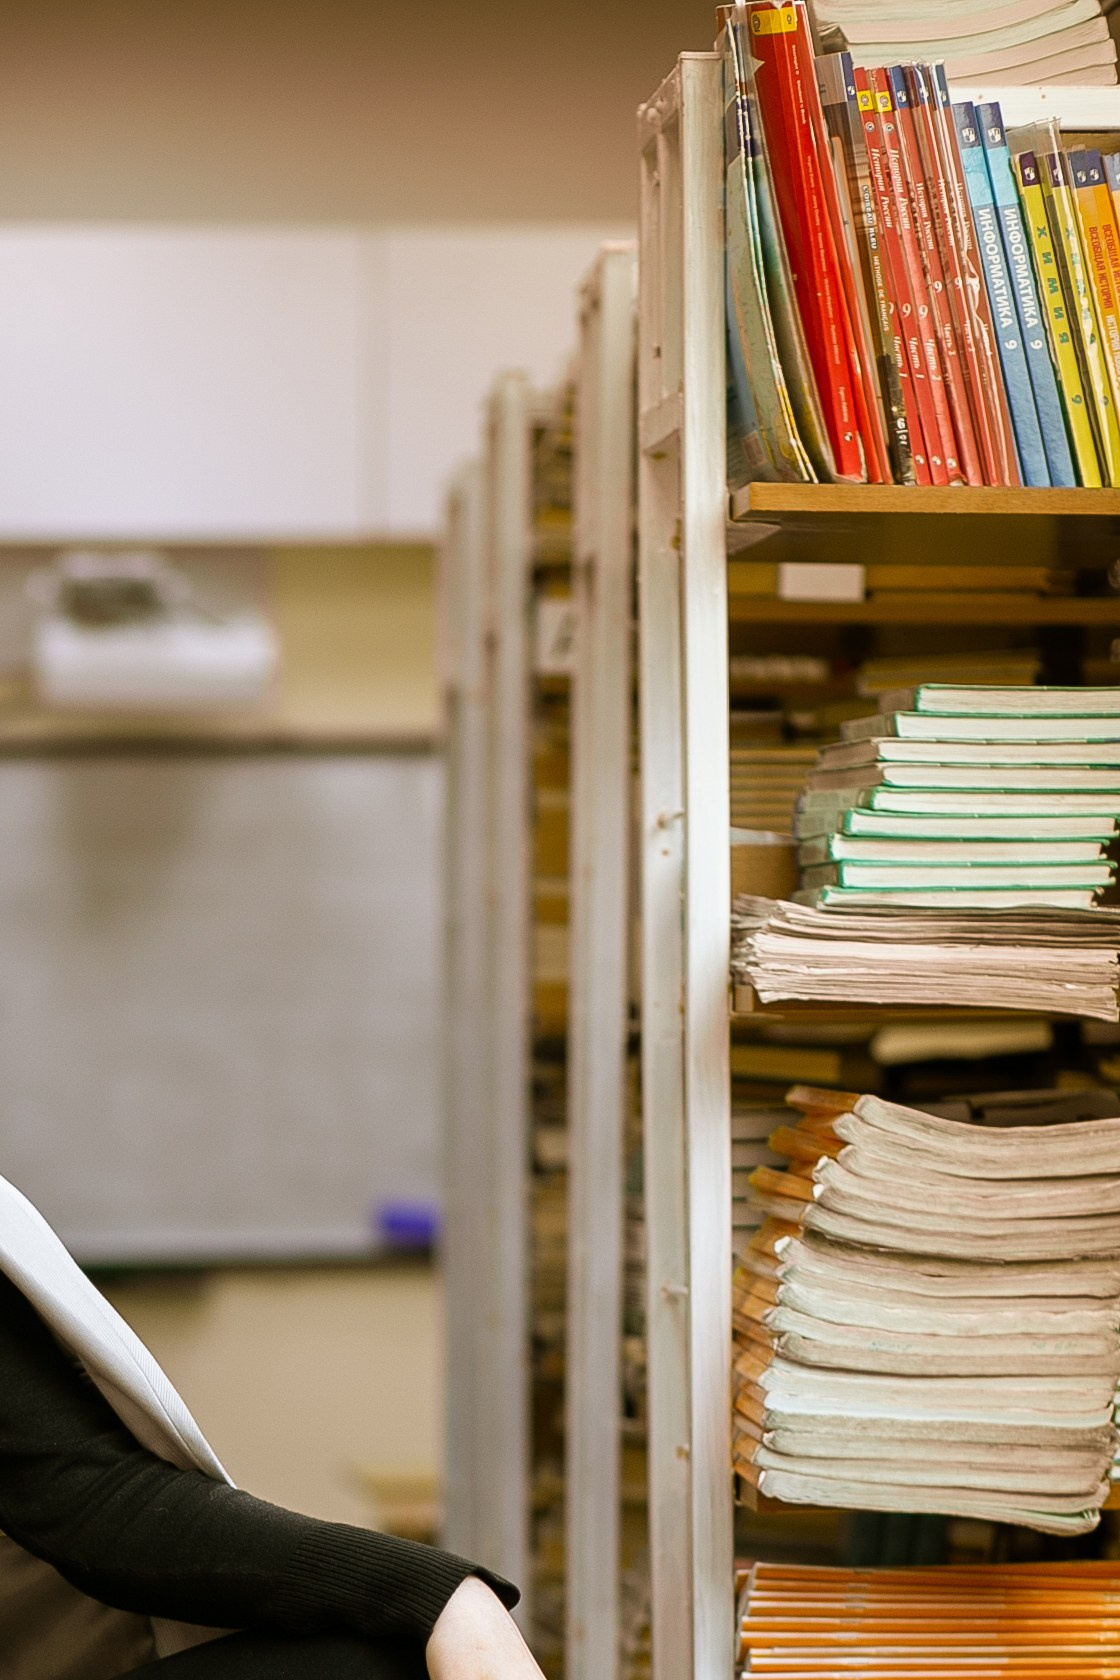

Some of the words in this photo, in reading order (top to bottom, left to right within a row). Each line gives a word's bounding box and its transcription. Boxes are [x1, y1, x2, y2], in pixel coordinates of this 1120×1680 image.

[890, 149, 903, 193] История
[898, 197, 911, 230] России
[869, 228, 877, 249] BLEU
[872, 148, 886, 191] История
[880, 196, 894, 229] России
[901, 303, 911, 317] 9
[909, 337, 920, 369] Часть
[1102, 224, 1119, 269] ВСЕОБЩАЯ
[915, 182, 928, 218] История
[923, 221, 936, 250] России
[932, 280, 943, 294] 9
[943, 323, 953, 348] Часть
[978, 208, 1013, 328] ИНФОРМАТИКА
[1004, 340, 1017, 349] 9
[1004, 208, 1038, 328] ИНФОРМАТИКА
[1031, 340, 1043, 349] 9
[1088, 227, 1106, 271] ВСЕОБЩАЯ
[1098, 273, 1113, 309] ИСТОРИЯ
[879, 290, 884, 298] DE
[918, 304, 929, 319] 9
[1037, 226, 1069, 344] ХИМИЯ
[1072, 394, 1082, 405] 9
[926, 339, 938, 371] Часть
[930, 373, 941, 381] 2
